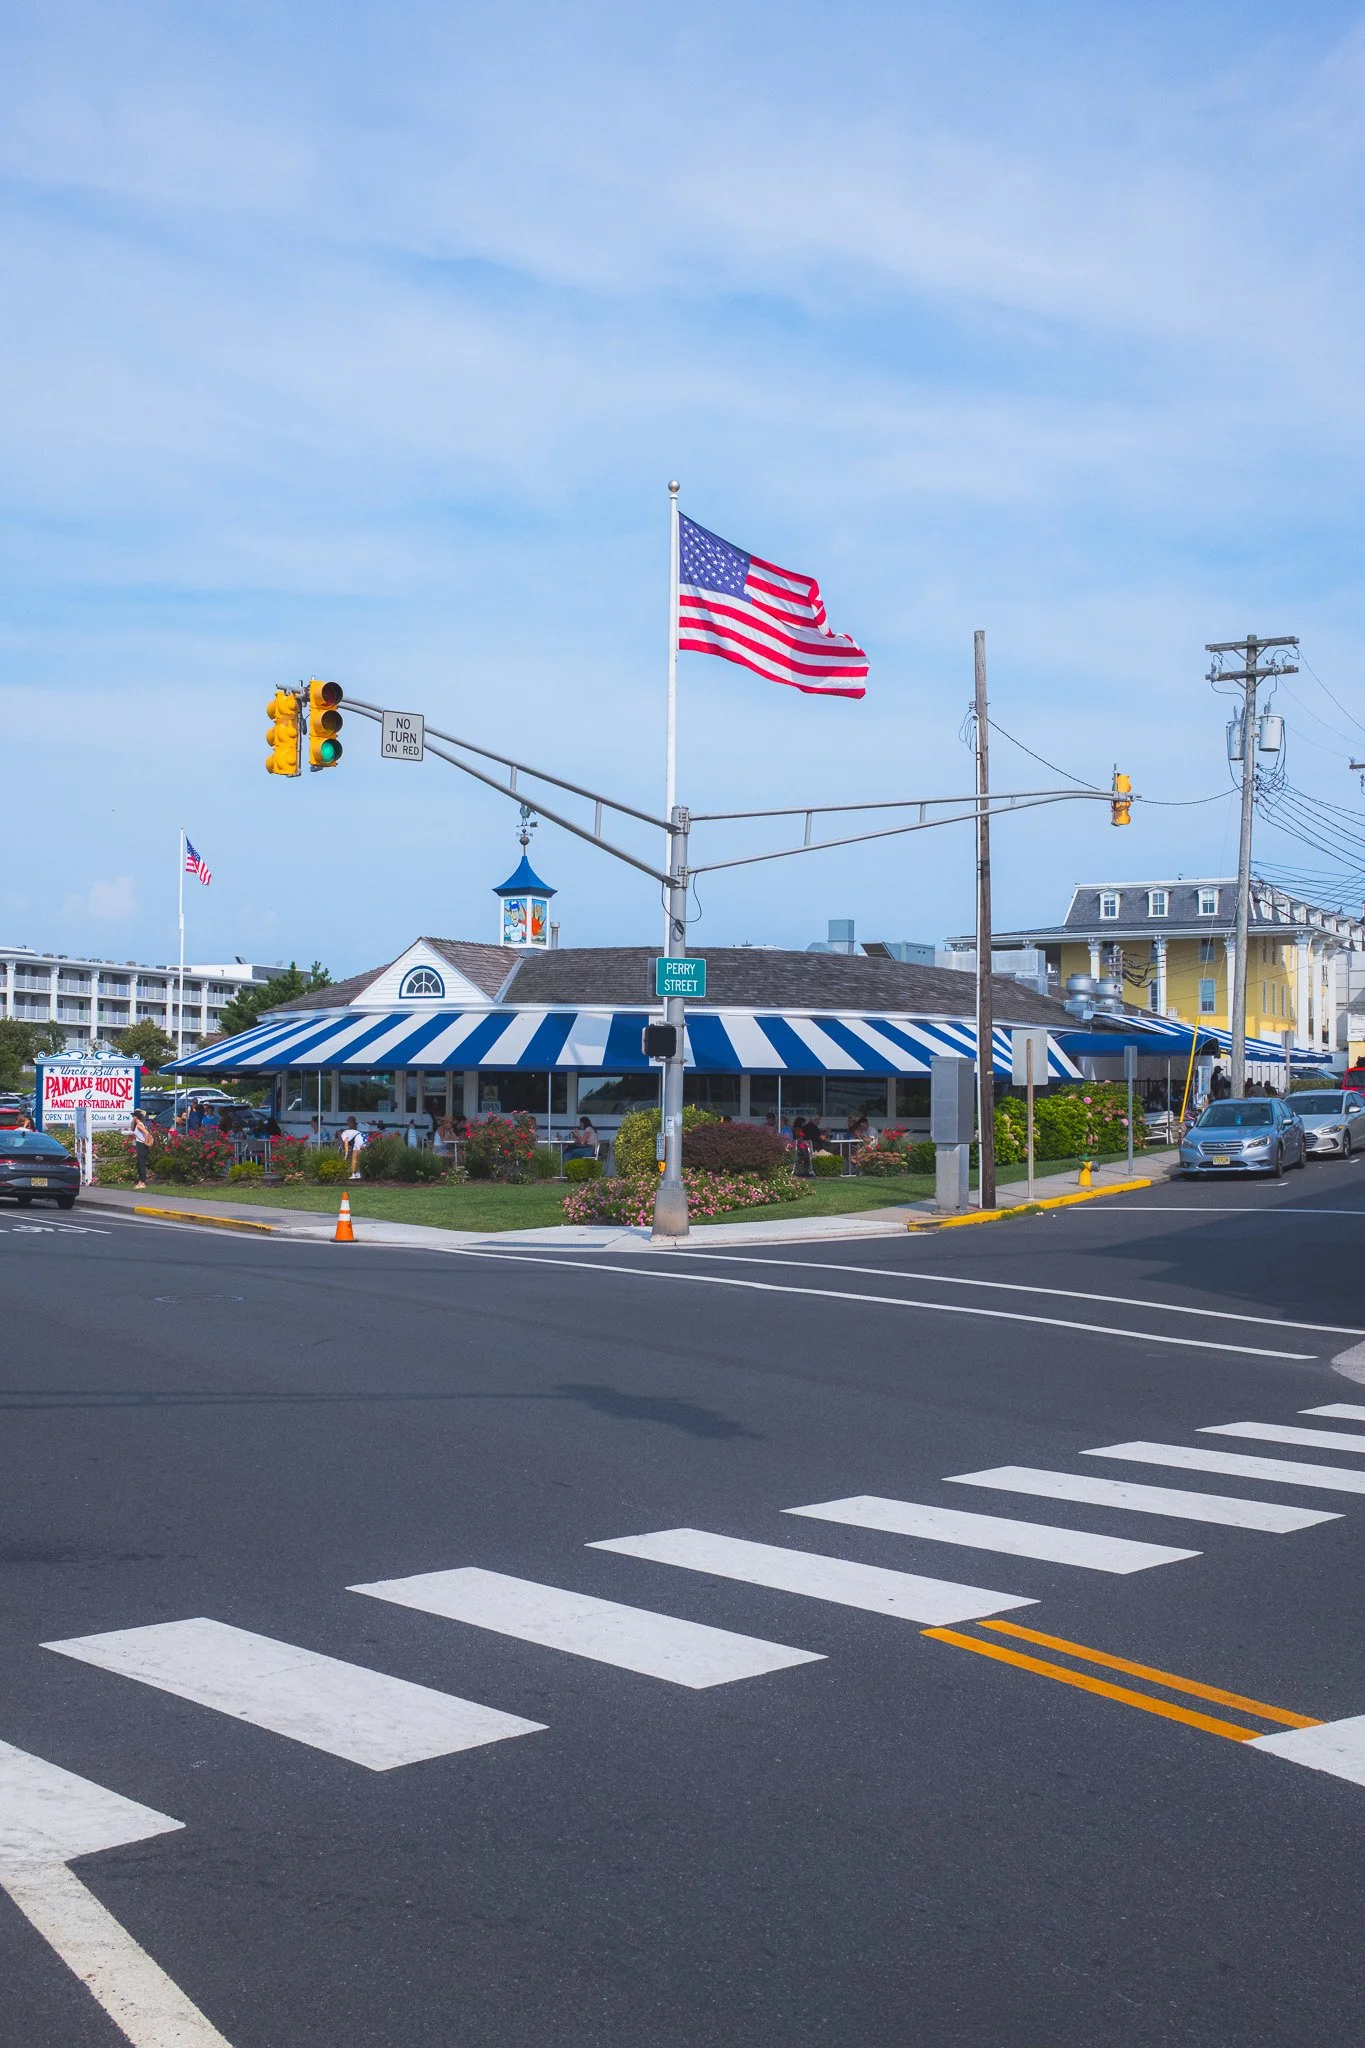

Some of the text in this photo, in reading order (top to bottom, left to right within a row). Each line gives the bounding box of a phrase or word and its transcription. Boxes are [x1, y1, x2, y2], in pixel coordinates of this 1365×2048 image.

[396, 717, 411, 730] NO
[389, 730, 417, 744] TURN
[385, 743, 420, 756] ON RED
[666, 962, 696, 975] PERRY
[664, 979, 698, 992] STREET
[60, 1065, 119, 1076] Uncle Bill's
[45, 1076, 133, 1100] PANCAKE HOUSE
[51, 1099, 126, 1109] FAMILY RESTAURANT
[45, 1113, 62, 1121] OPEN
